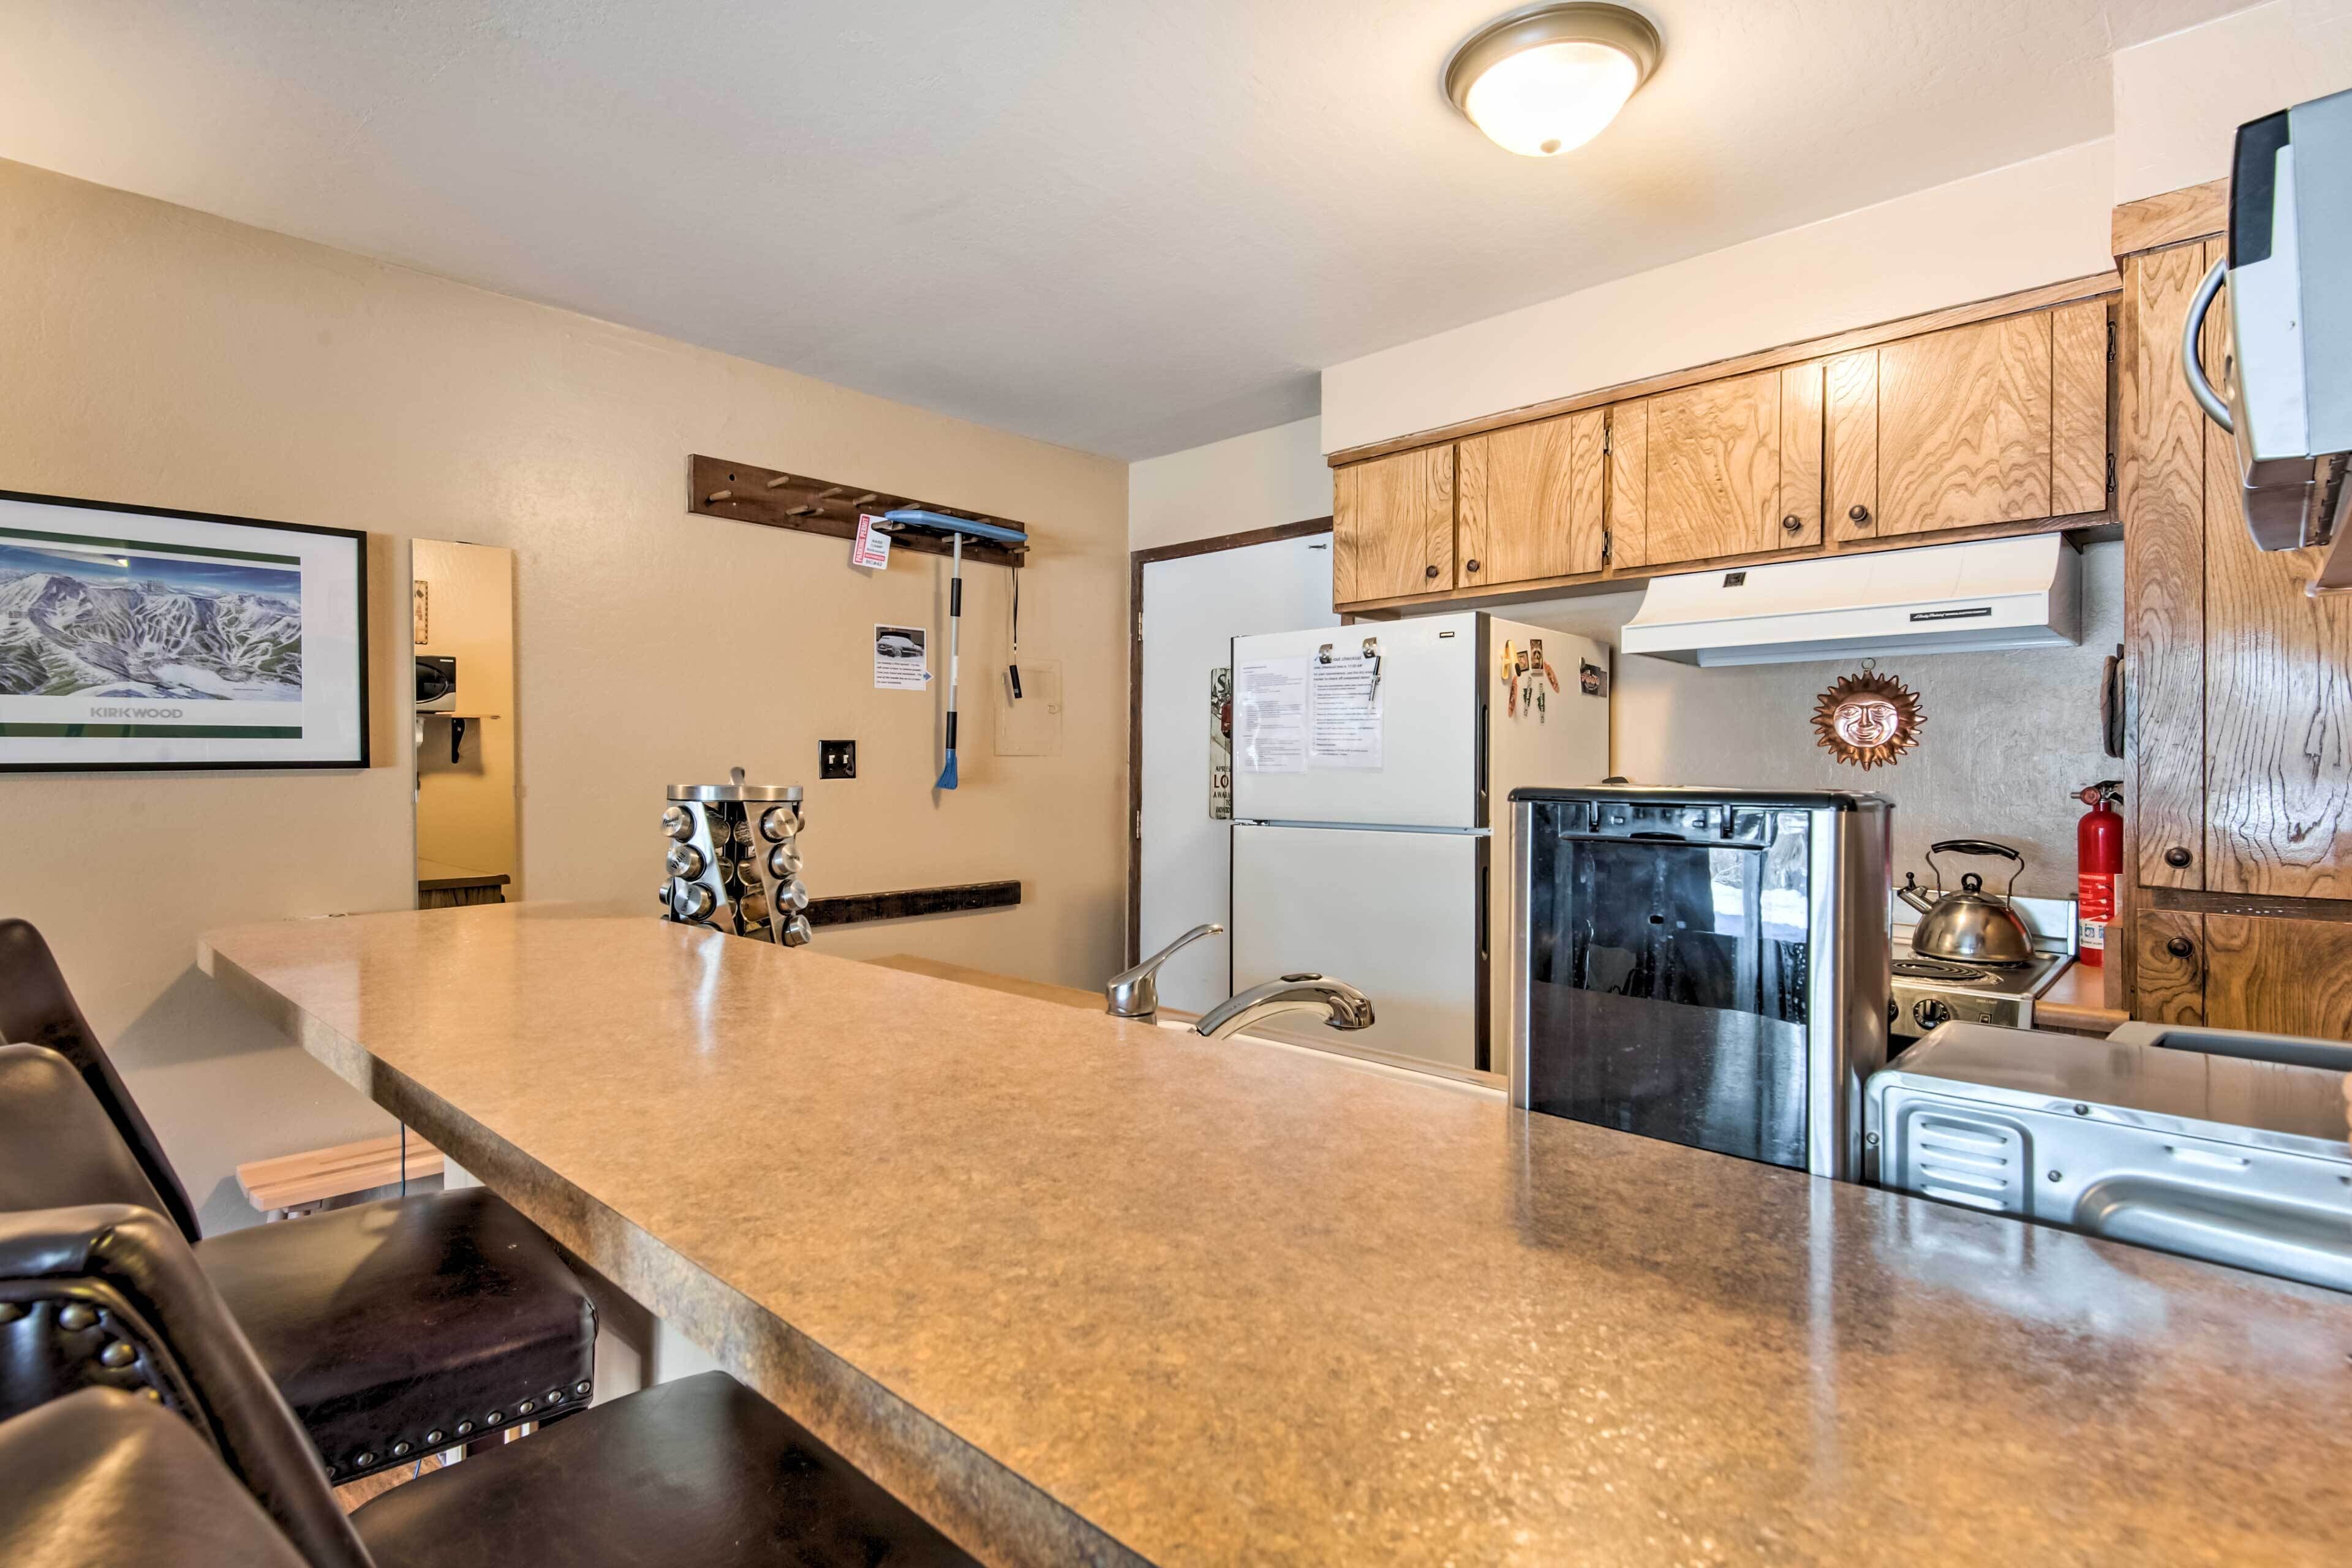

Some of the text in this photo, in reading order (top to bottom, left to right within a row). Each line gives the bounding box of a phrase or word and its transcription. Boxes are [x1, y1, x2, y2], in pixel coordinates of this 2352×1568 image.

[860, 518, 869, 537] PERMIT
[90, 707, 183, 718] KIRKWOOD
[1214, 774, 1229, 788] LO
[671, 852, 685, 869] PIZZA
